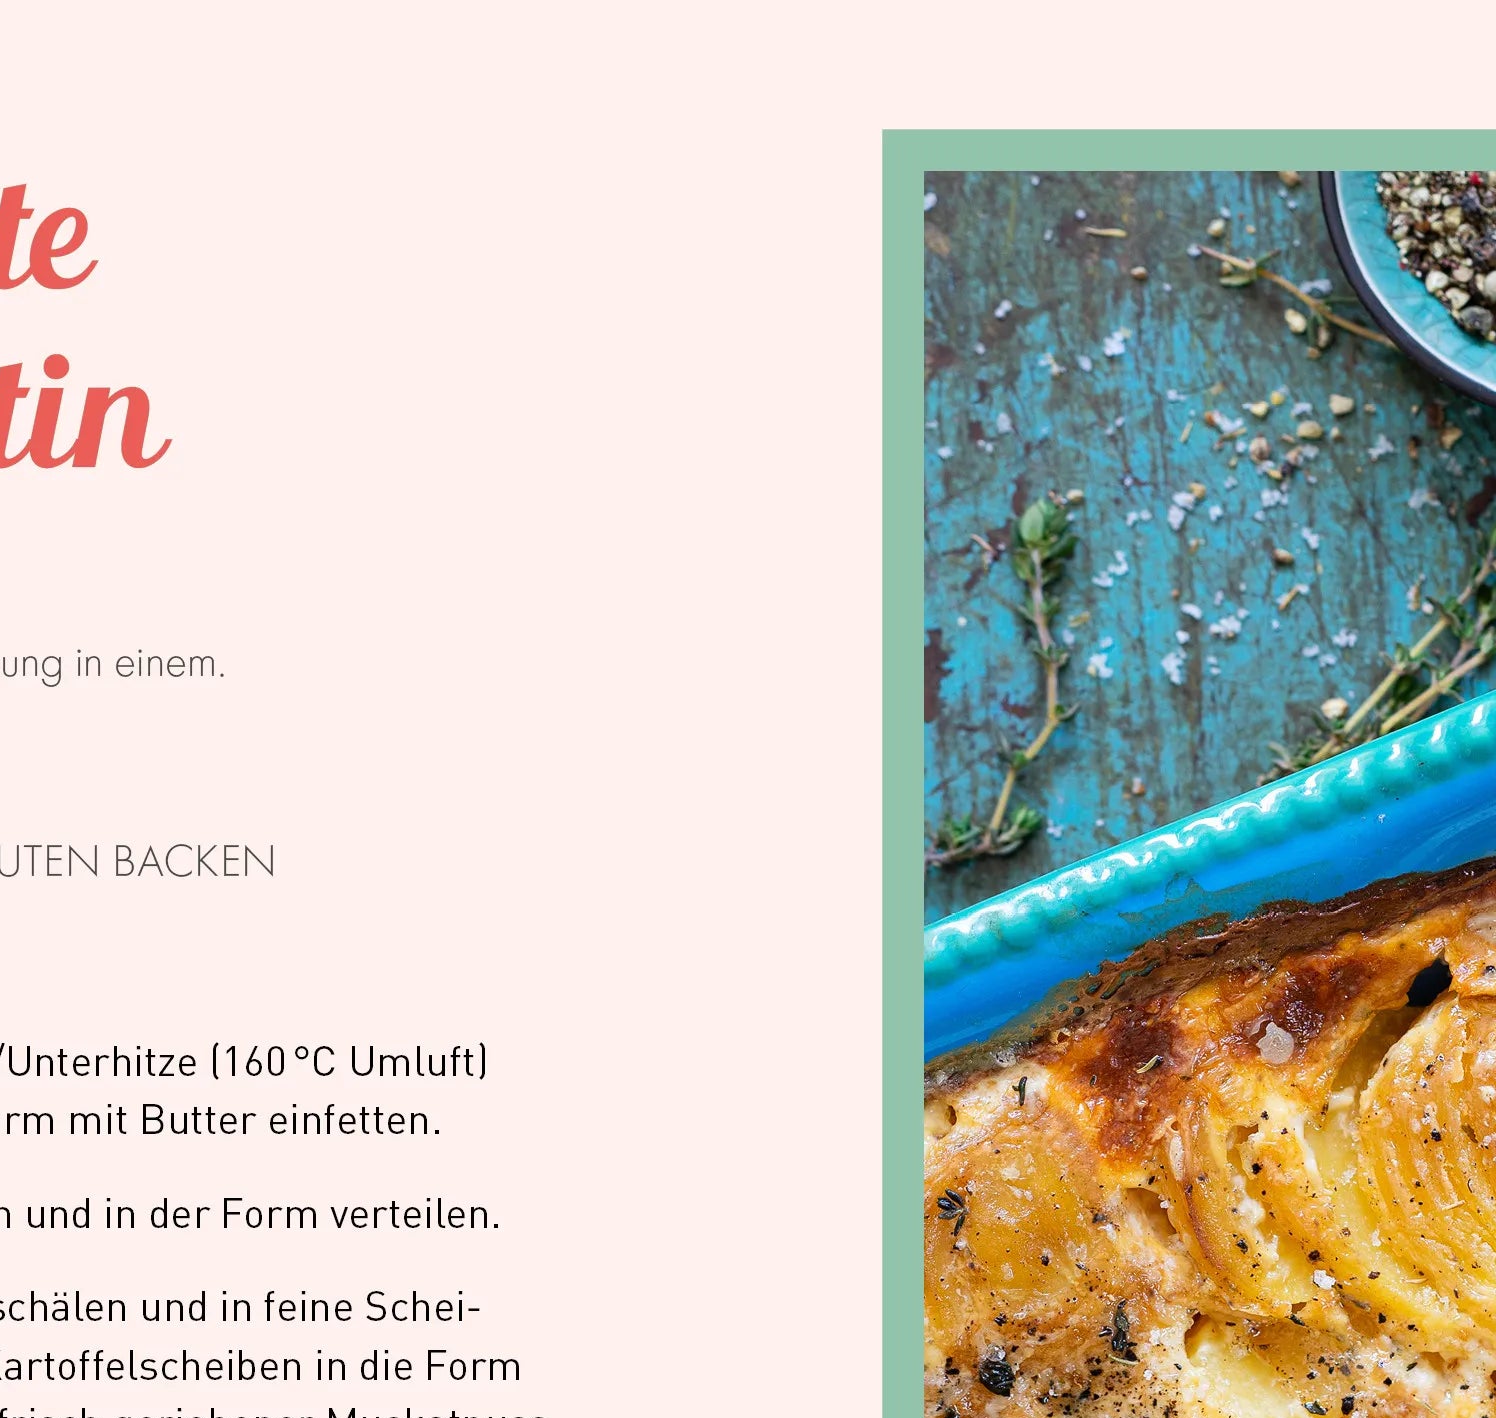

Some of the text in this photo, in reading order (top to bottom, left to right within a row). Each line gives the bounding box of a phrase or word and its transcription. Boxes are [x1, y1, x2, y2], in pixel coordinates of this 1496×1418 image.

[76, 648, 101, 677] in
[115, 648, 225, 678] einem.
[115, 843, 274, 878] BACKEN
[351, 1041, 486, 1081] Umluft)
[70, 1103, 128, 1135] mit
[142, 1103, 258, 1135] Butter
[269, 1103, 440, 1135] einfetten.
[27, 1197, 90, 1229] und
[105, 1197, 135, 1229] in
[150, 1197, 212, 1229] der
[223, 1197, 317, 1229] Form
[329, 1197, 499, 1229] verteilen.
[142, 1290, 206, 1322] und
[221, 1290, 251, 1322] in
[263, 1290, 353, 1322] feine
[365, 1289, 481, 1322] Schei-
[316, 1349, 346, 1381] in
[360, 1349, 413, 1381] die
[427, 1349, 520, 1381] Form
